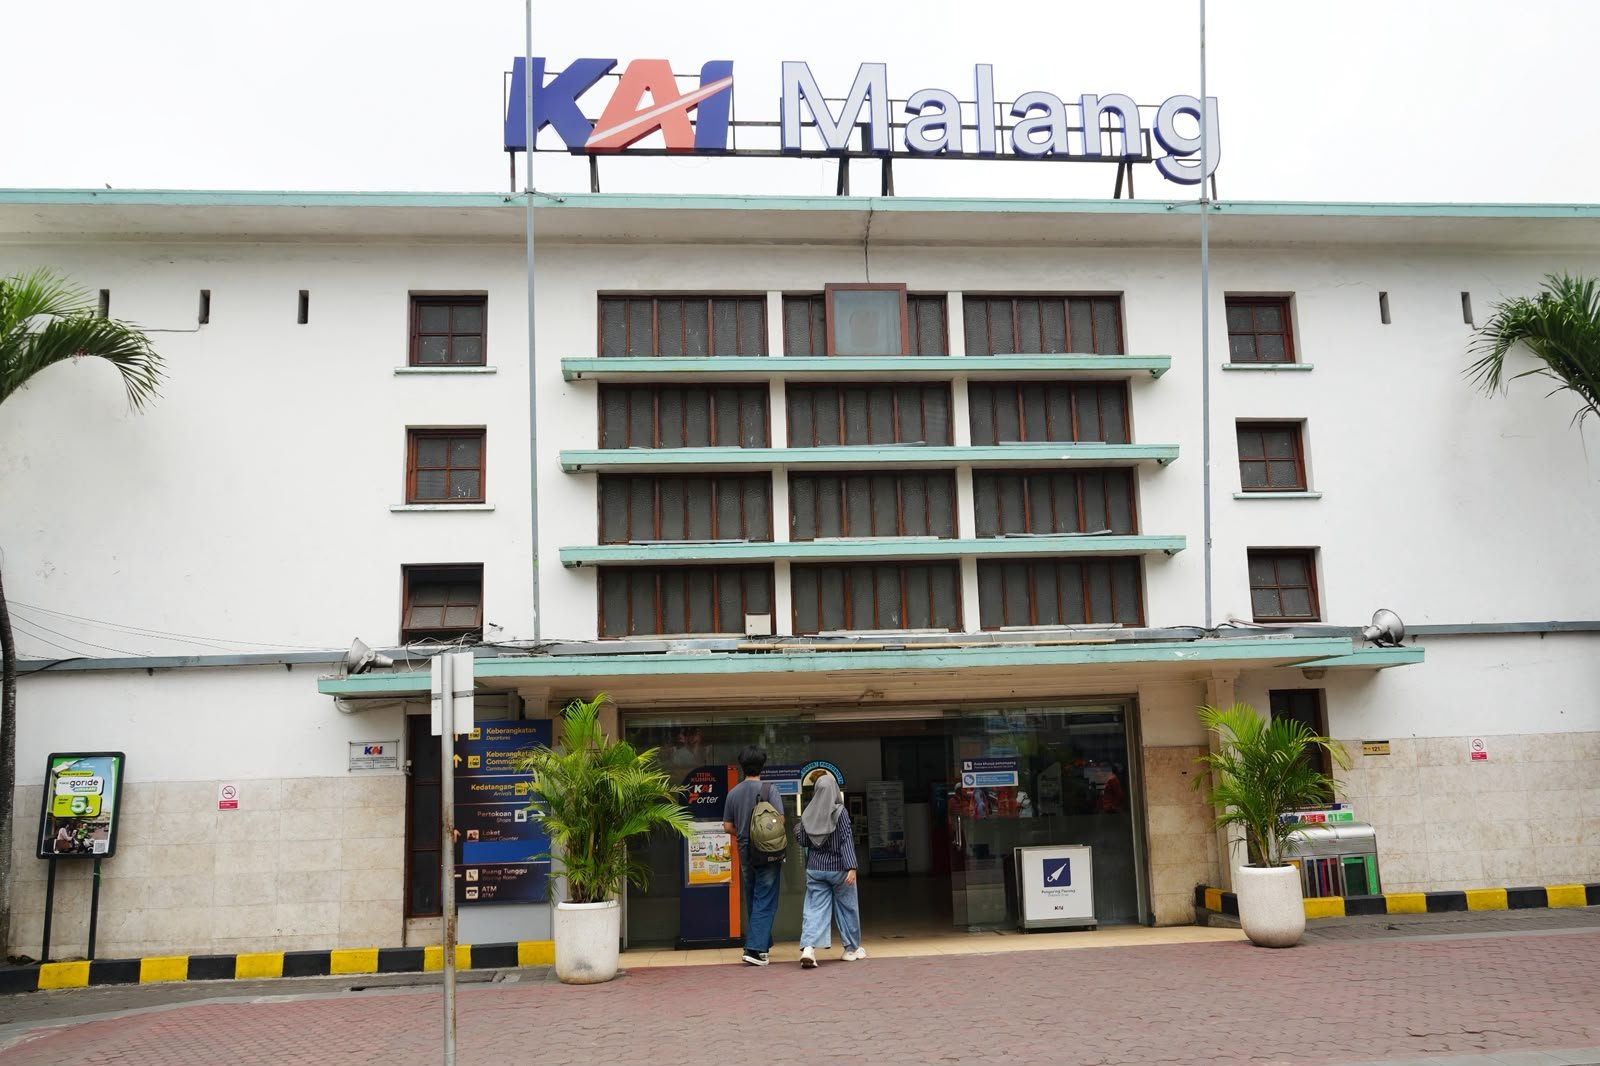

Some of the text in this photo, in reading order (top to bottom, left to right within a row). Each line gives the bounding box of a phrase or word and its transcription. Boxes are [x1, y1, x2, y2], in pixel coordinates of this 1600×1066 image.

[504, 57, 1219, 185] KAI Malang
[70, 779, 99, 788] goride
[71, 797, 87, 813] 5
[688, 792, 719, 804] Porter
